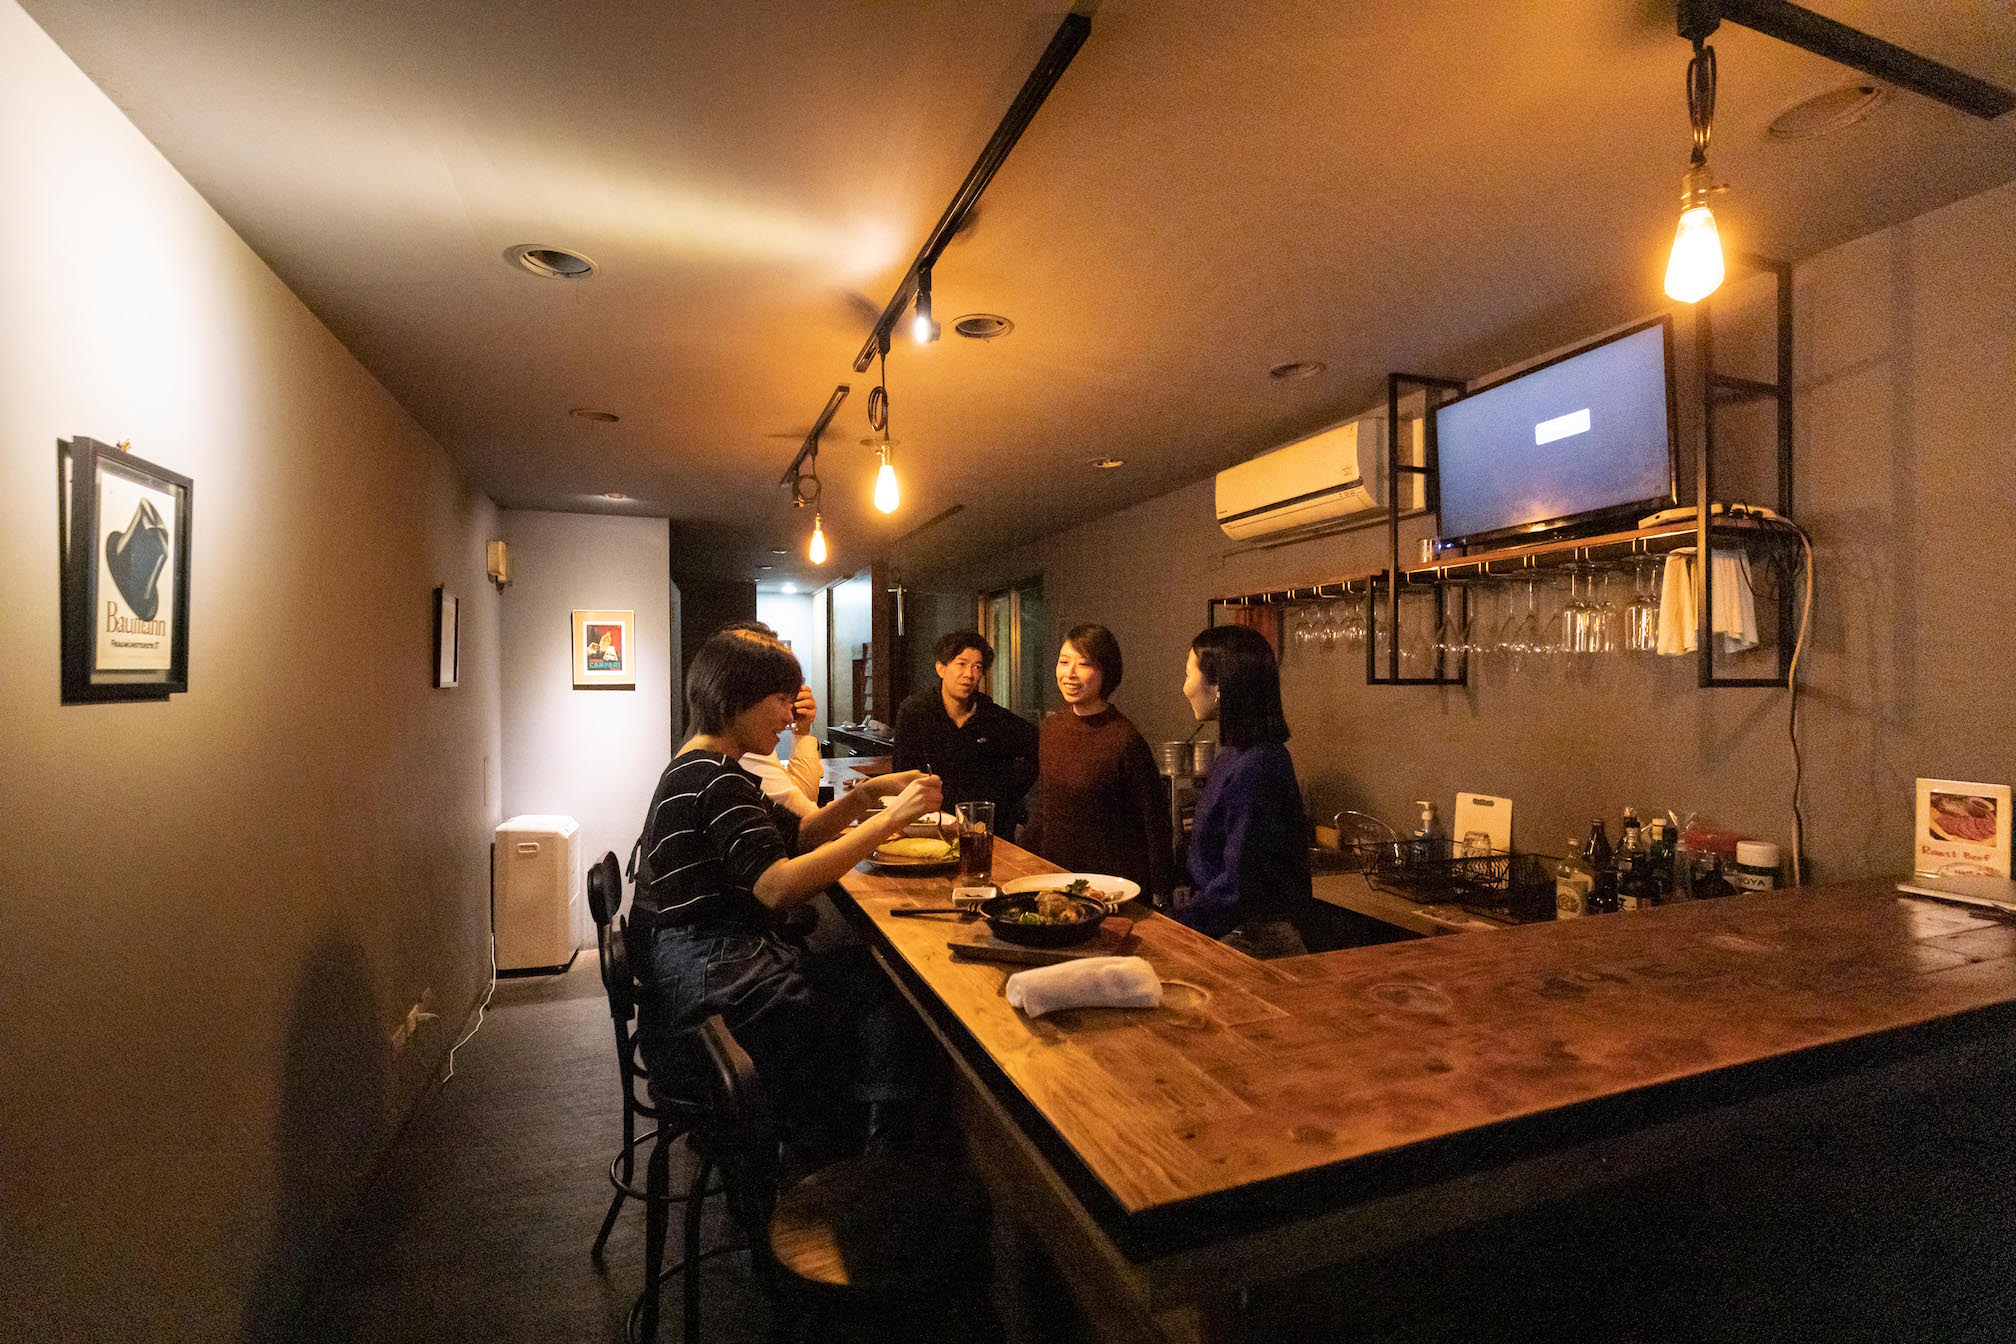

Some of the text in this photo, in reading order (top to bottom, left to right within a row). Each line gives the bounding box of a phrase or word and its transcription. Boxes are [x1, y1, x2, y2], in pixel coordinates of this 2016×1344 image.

[106, 600, 166, 636] Baumann
[589, 661, 621, 669] CAMPARI
[1921, 845, 1991, 862] Roast Beef
